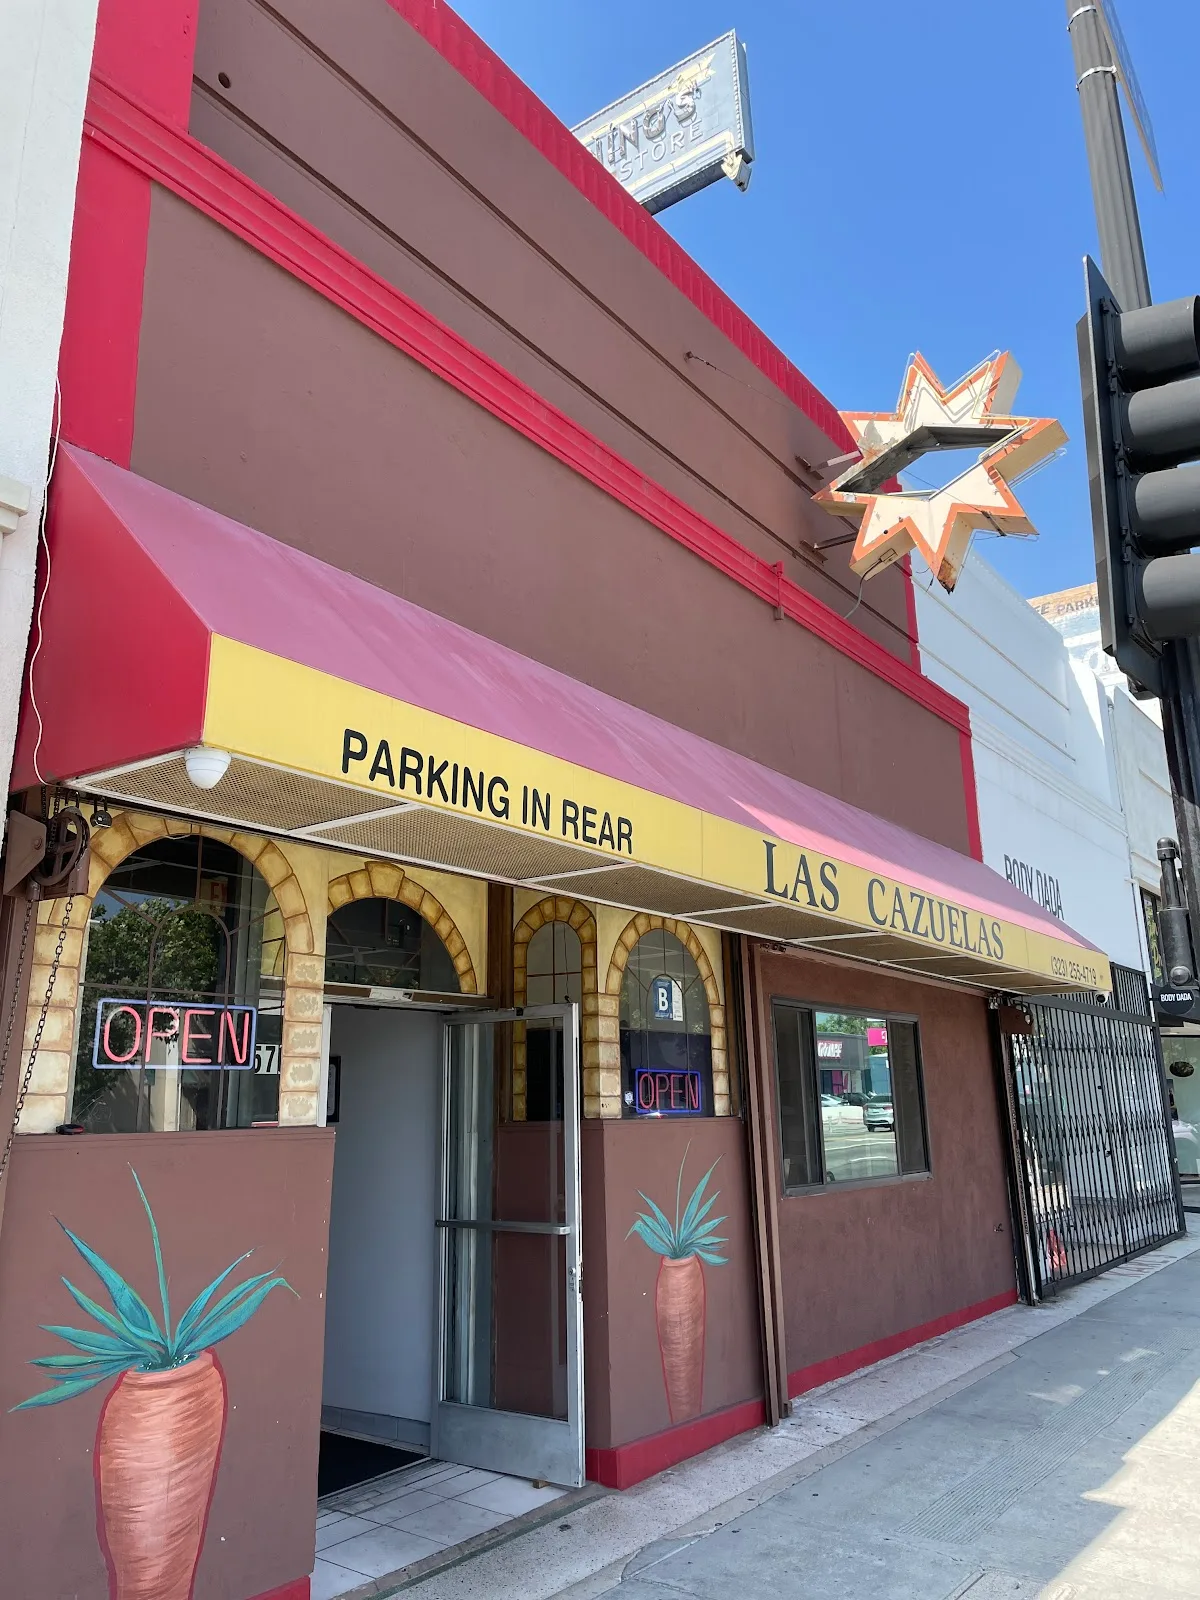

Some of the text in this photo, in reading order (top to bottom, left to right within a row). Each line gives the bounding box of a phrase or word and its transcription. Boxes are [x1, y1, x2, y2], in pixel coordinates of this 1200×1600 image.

[619, 118, 703, 182] STORE
[341, 728, 633, 854] PARKING IN REAR
[762, 839, 1004, 961] LAS CAZUELAS
[1003, 853, 1065, 921] BODY DADA
[658, 987, 669, 1011] B
[1161, 993, 1193, 1003] BODY DADA
[103, 1005, 250, 1063] OPEN
[638, 1074, 699, 1109] OPEN
